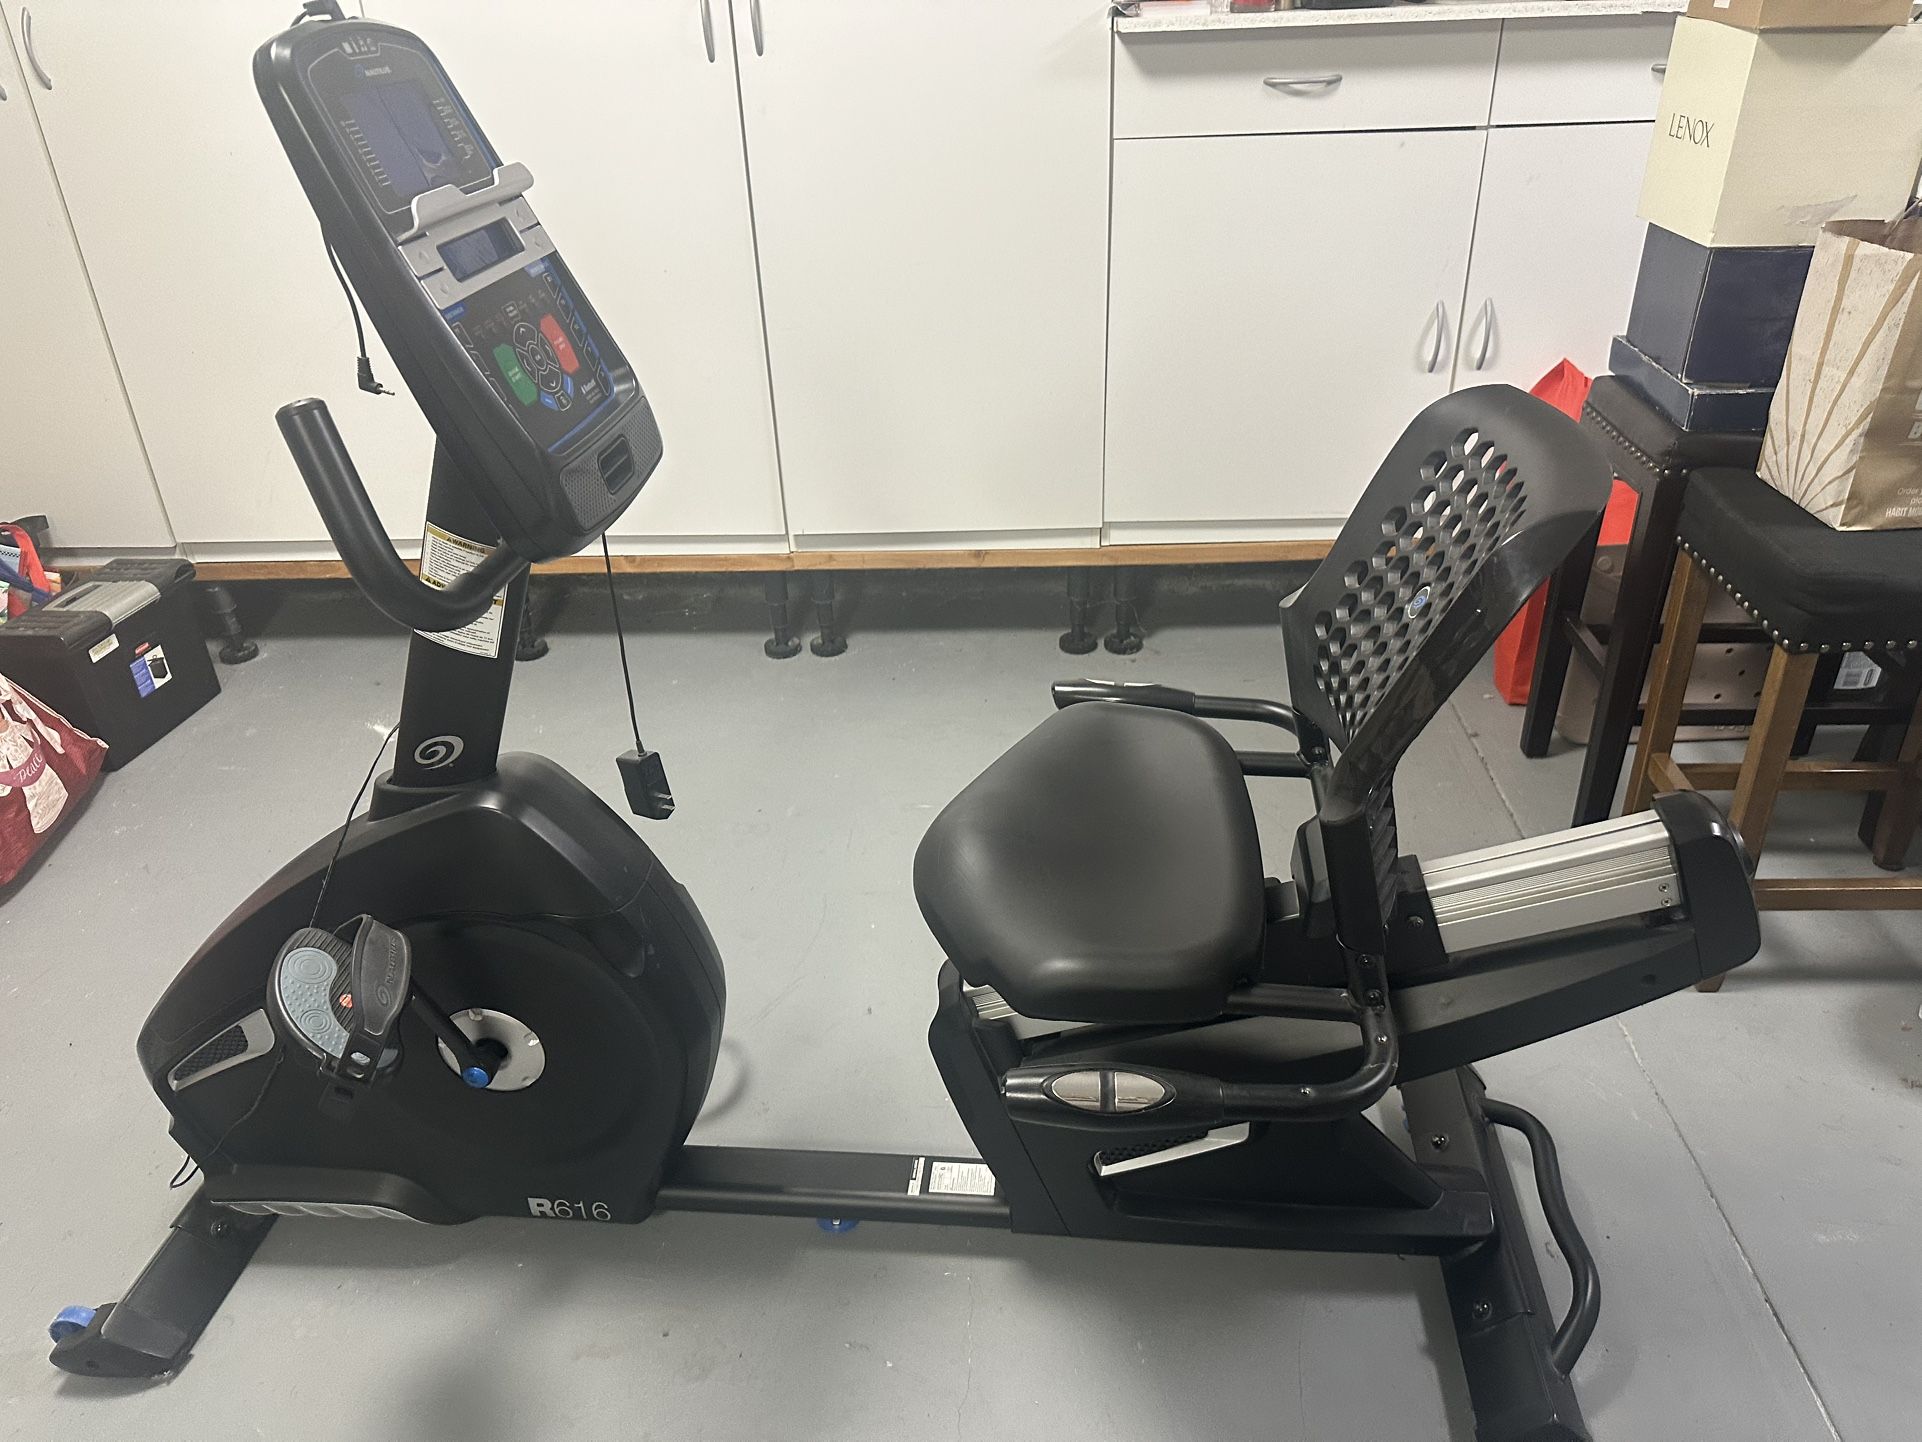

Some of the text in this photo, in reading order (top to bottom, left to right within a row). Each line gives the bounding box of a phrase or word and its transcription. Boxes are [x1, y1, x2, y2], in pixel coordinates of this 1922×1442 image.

[1668, 112, 1715, 148] LENOX
[1885, 507, 1908, 518] HABIT
[452, 539, 486, 554] WARNING
[527, 1197, 611, 1221] R616
